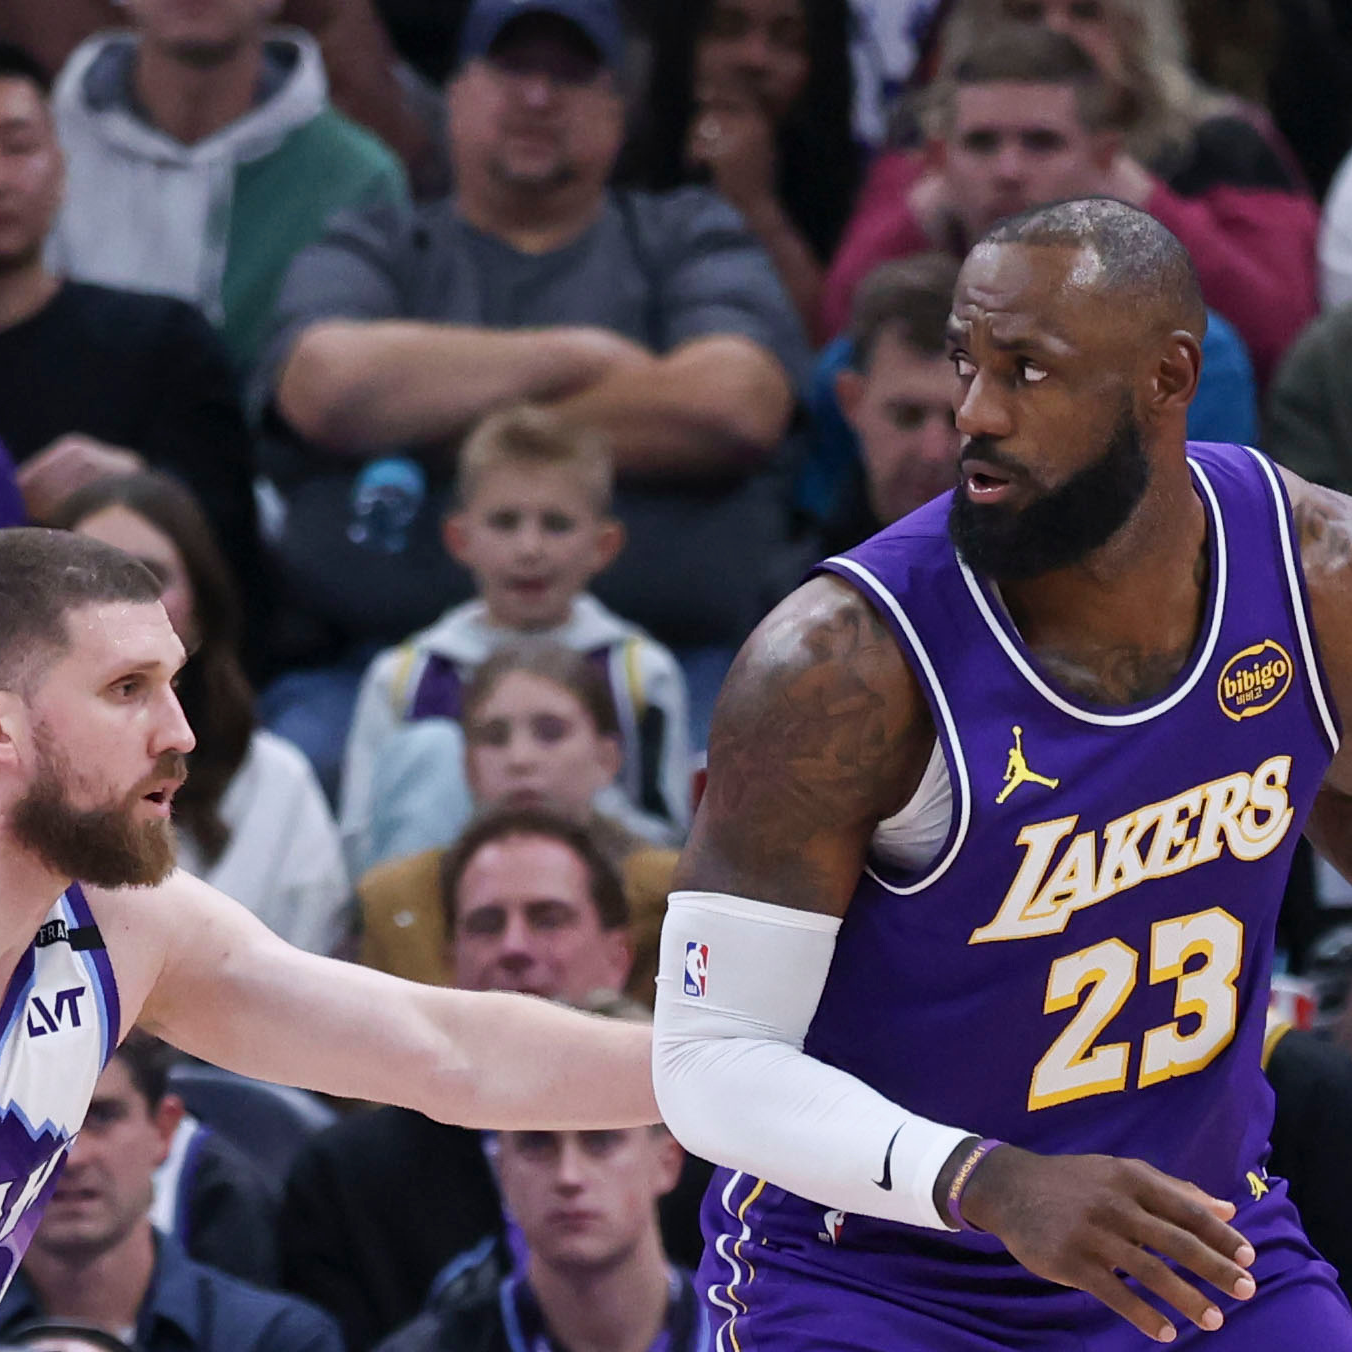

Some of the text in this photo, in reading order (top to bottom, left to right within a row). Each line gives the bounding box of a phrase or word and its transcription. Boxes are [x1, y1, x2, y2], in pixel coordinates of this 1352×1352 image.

[1223, 660, 1287, 699] bibigo
[967, 755, 1294, 945] LAKERS
[27, 985, 86, 1039] LVT
[1027, 906, 1244, 1112] 23
